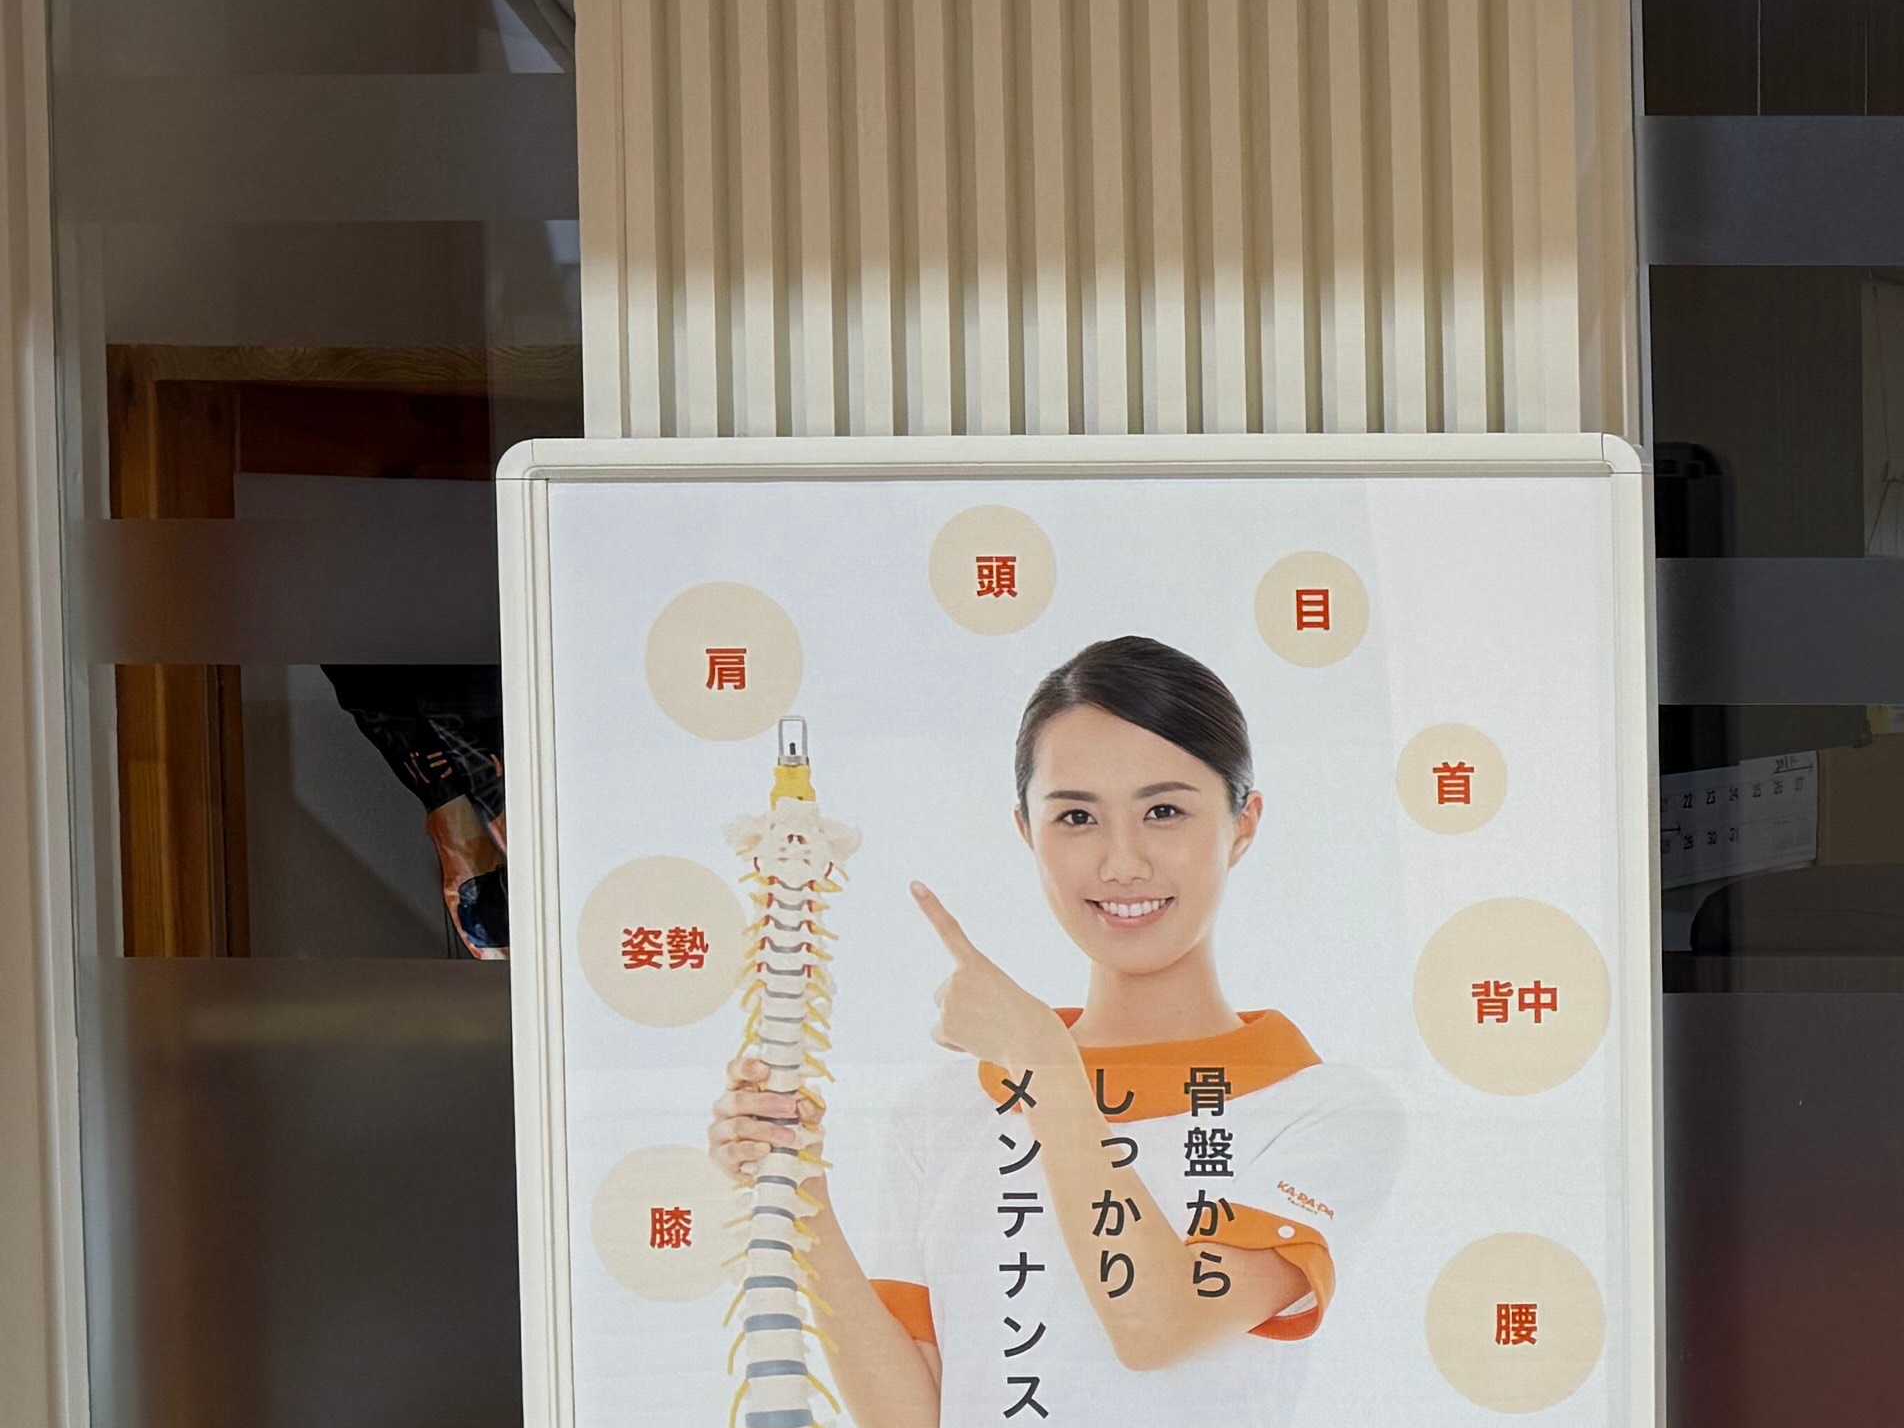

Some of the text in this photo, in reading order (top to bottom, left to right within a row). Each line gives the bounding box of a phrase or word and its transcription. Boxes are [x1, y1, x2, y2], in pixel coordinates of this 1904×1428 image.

[976, 557, 1017, 597] 頭
[1296, 589, 1329, 630] 目
[706, 649, 746, 690] 肩
[1433, 762, 1474, 804] 首
[622, 927, 708, 969] 姿勢
[1472, 980, 1557, 1023] 背中
[1092, 1069, 1142, 1298] しっかり
[1182, 1067, 1236, 1298] 骨盤から
[650, 1207, 691, 1248] 膝
[995, 1069, 1049, 1419] メンテナンス
[1496, 1304, 1537, 1345] 腰
